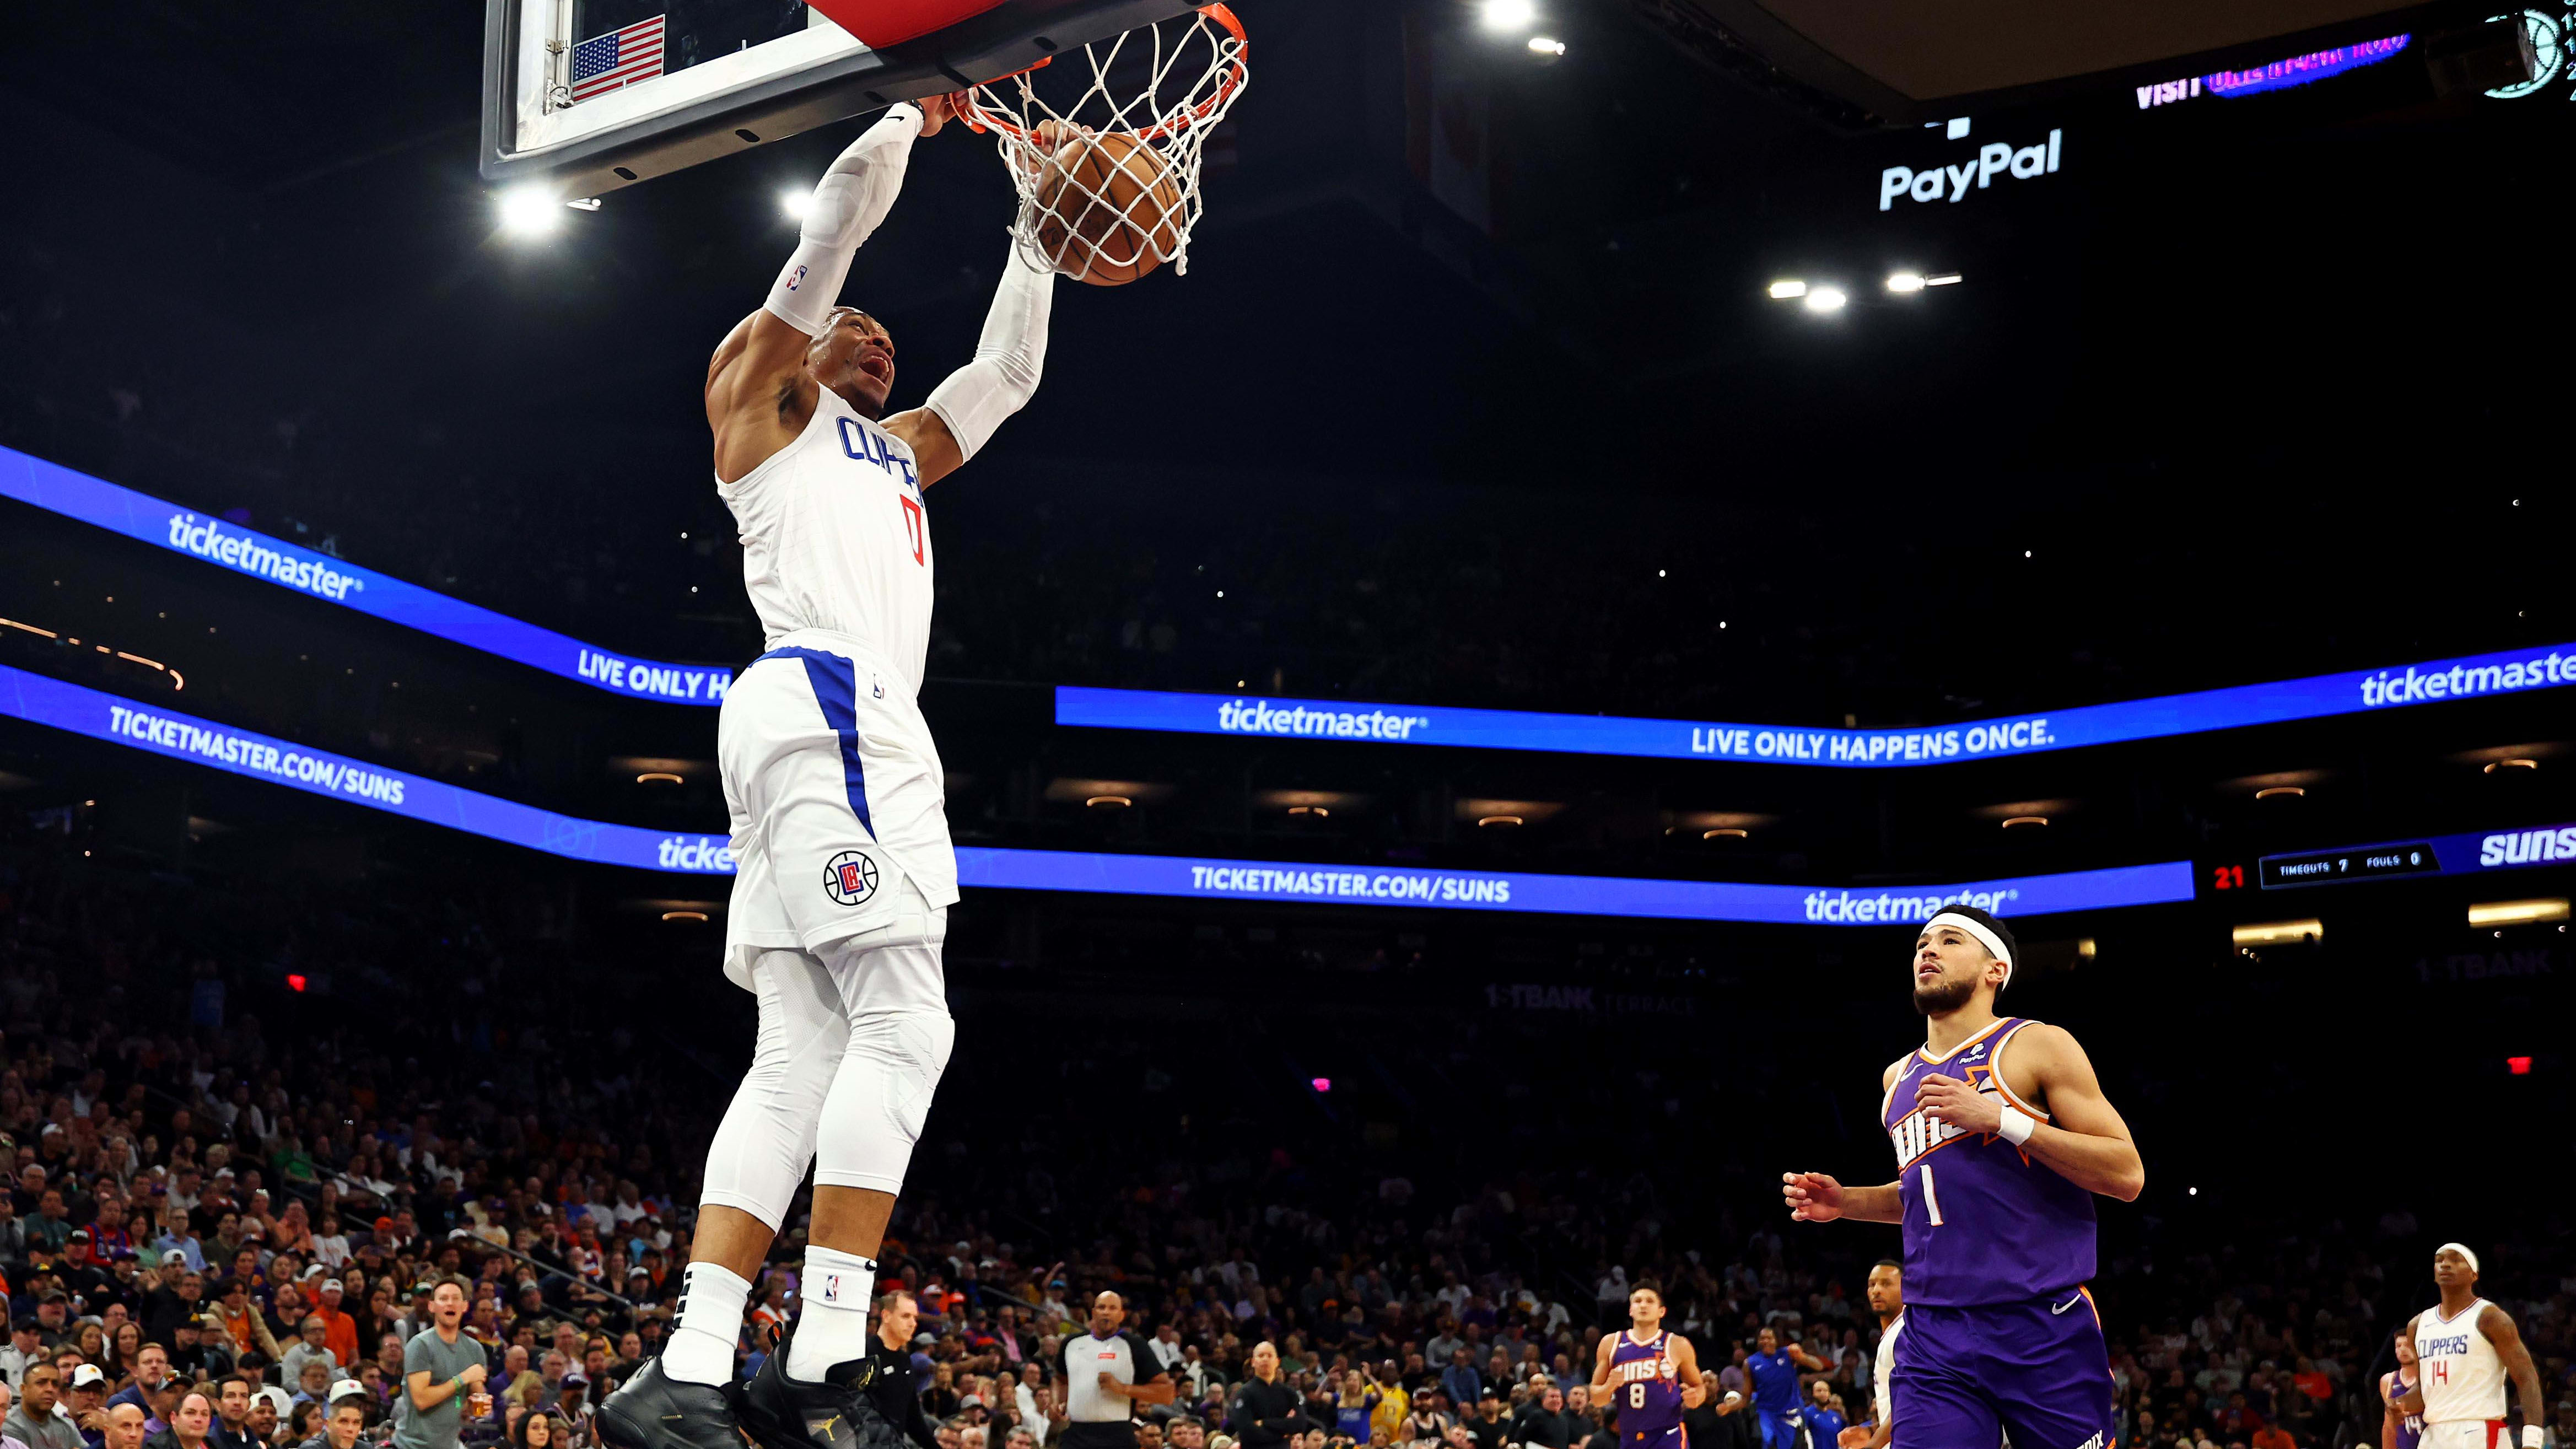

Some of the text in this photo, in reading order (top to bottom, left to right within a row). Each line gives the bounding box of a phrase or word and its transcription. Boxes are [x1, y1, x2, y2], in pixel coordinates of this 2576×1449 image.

[2136, 77, 2201, 110] VISIT
[1879, 128, 2062, 212] PayPal
[169, 513, 354, 600] ticketmaster
[578, 649, 626, 688] LIVE
[628, 665, 705, 698] ONLY
[1218, 699, 1417, 739] ticketmaster
[109, 705, 405, 806] TICKETMASTER.COM/SUNS
[1692, 719, 2055, 761] LIVE ONLY HAPPENS ONCE.
[2214, 865, 2244, 890] 21
[2279, 852, 2421, 876] TIMEOUTS 7 FOULS 0
[1191, 866, 1510, 903] TICKETMASTER.COM/SUNS
[1959, 1052, 1986, 1064] PayPal
[1920, 1164, 1943, 1226] 1
[2418, 1334, 2468, 1360] CLIPPERS
[2432, 1360, 2448, 1387] 14
[1630, 1382, 1645, 1409] 8
